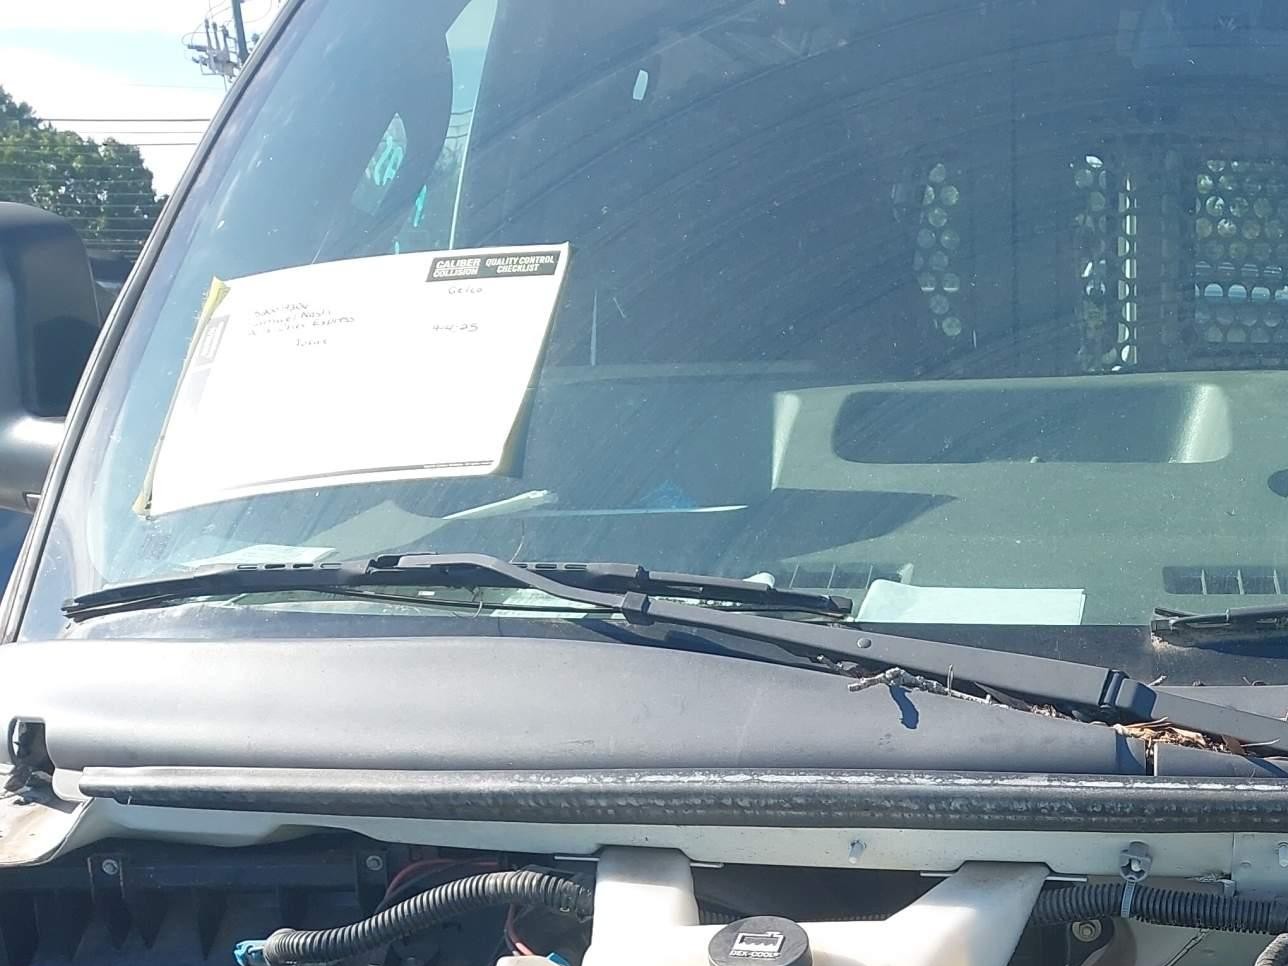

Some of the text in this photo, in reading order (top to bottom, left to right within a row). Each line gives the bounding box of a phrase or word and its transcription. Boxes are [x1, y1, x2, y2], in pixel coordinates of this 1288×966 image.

[436, 258, 481, 269] CALIBER
[485, 255, 555, 268] QUALITY CONTROL
[433, 267, 479, 278] COLLISION
[496, 263, 540, 274] CHECKLIST
